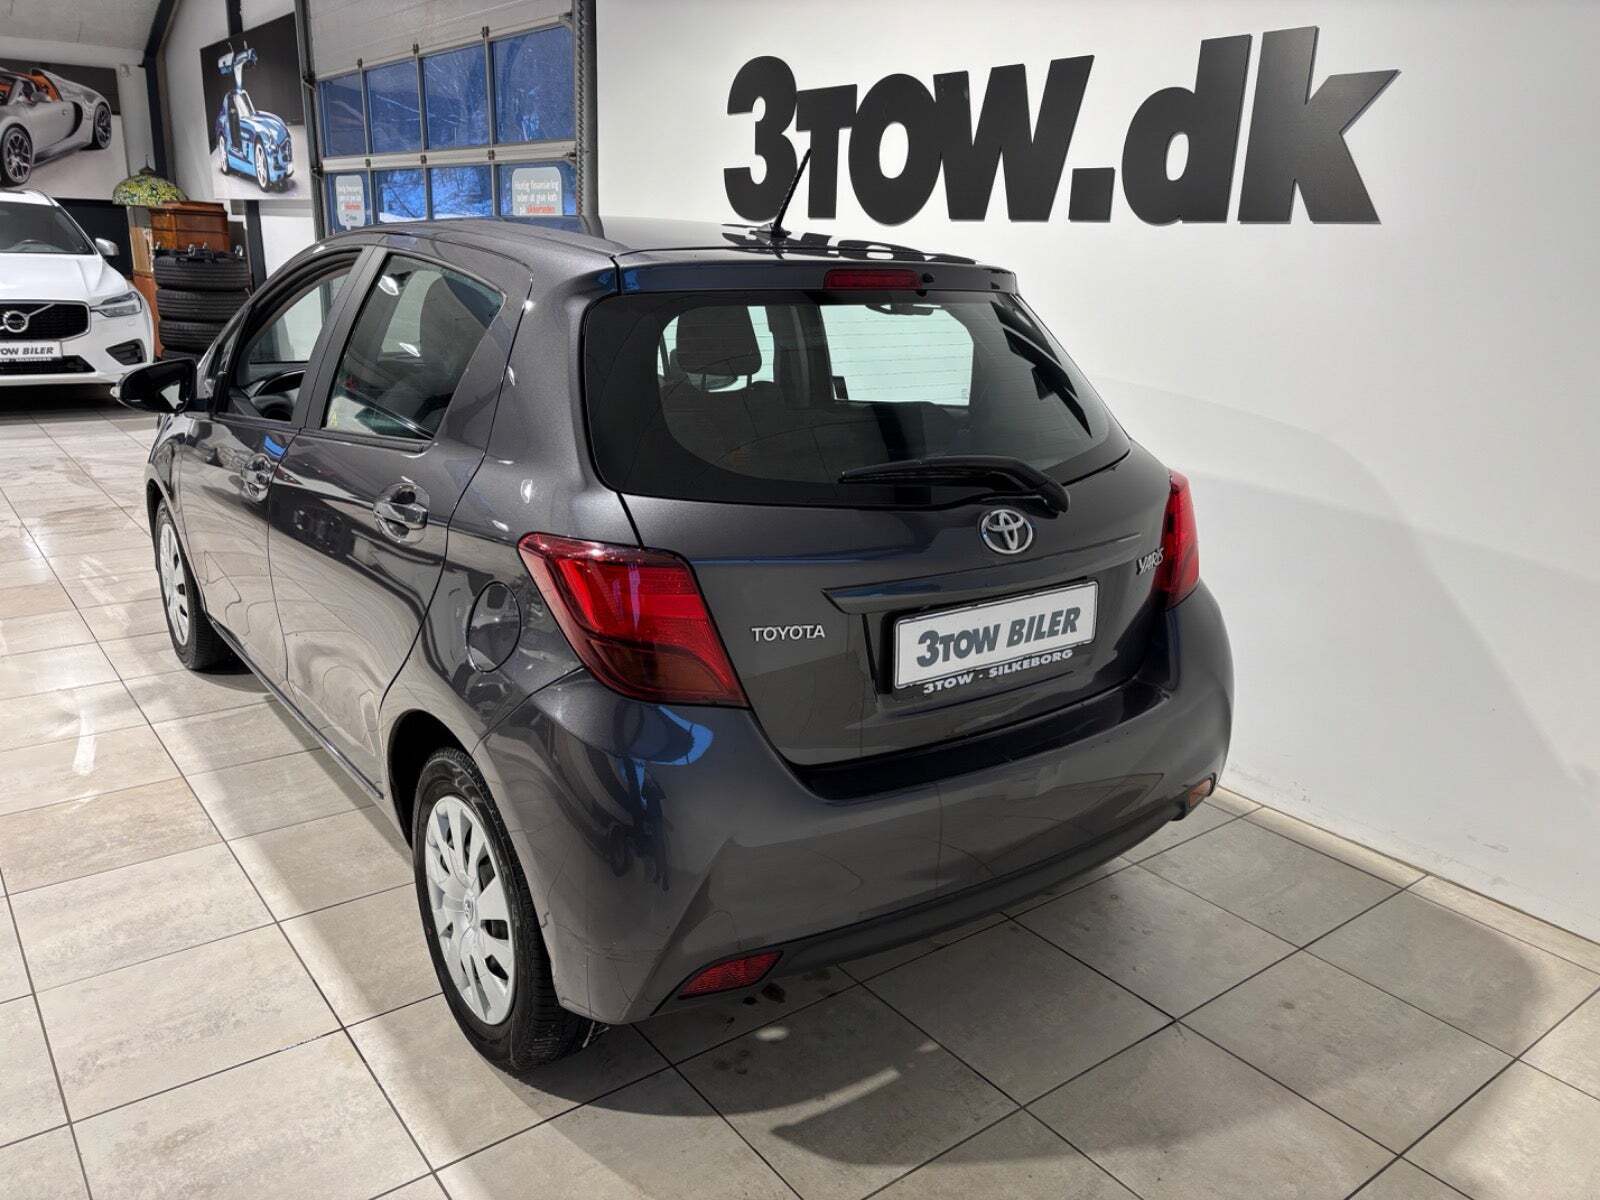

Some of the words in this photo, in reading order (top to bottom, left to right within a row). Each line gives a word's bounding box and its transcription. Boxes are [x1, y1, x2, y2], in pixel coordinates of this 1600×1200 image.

[723, 25, 1402, 226] 3TOW.dk
[22, 347, 53, 355] BILER
[1137, 547, 1164, 575] YARIS
[751, 625, 825, 642] TOYOTA
[916, 623, 1001, 668] 3TOW
[1005, 606, 1081, 648] BILER
[922, 673, 974, 694] 3TOW
[988, 649, 1073, 677] SILKEBORG
